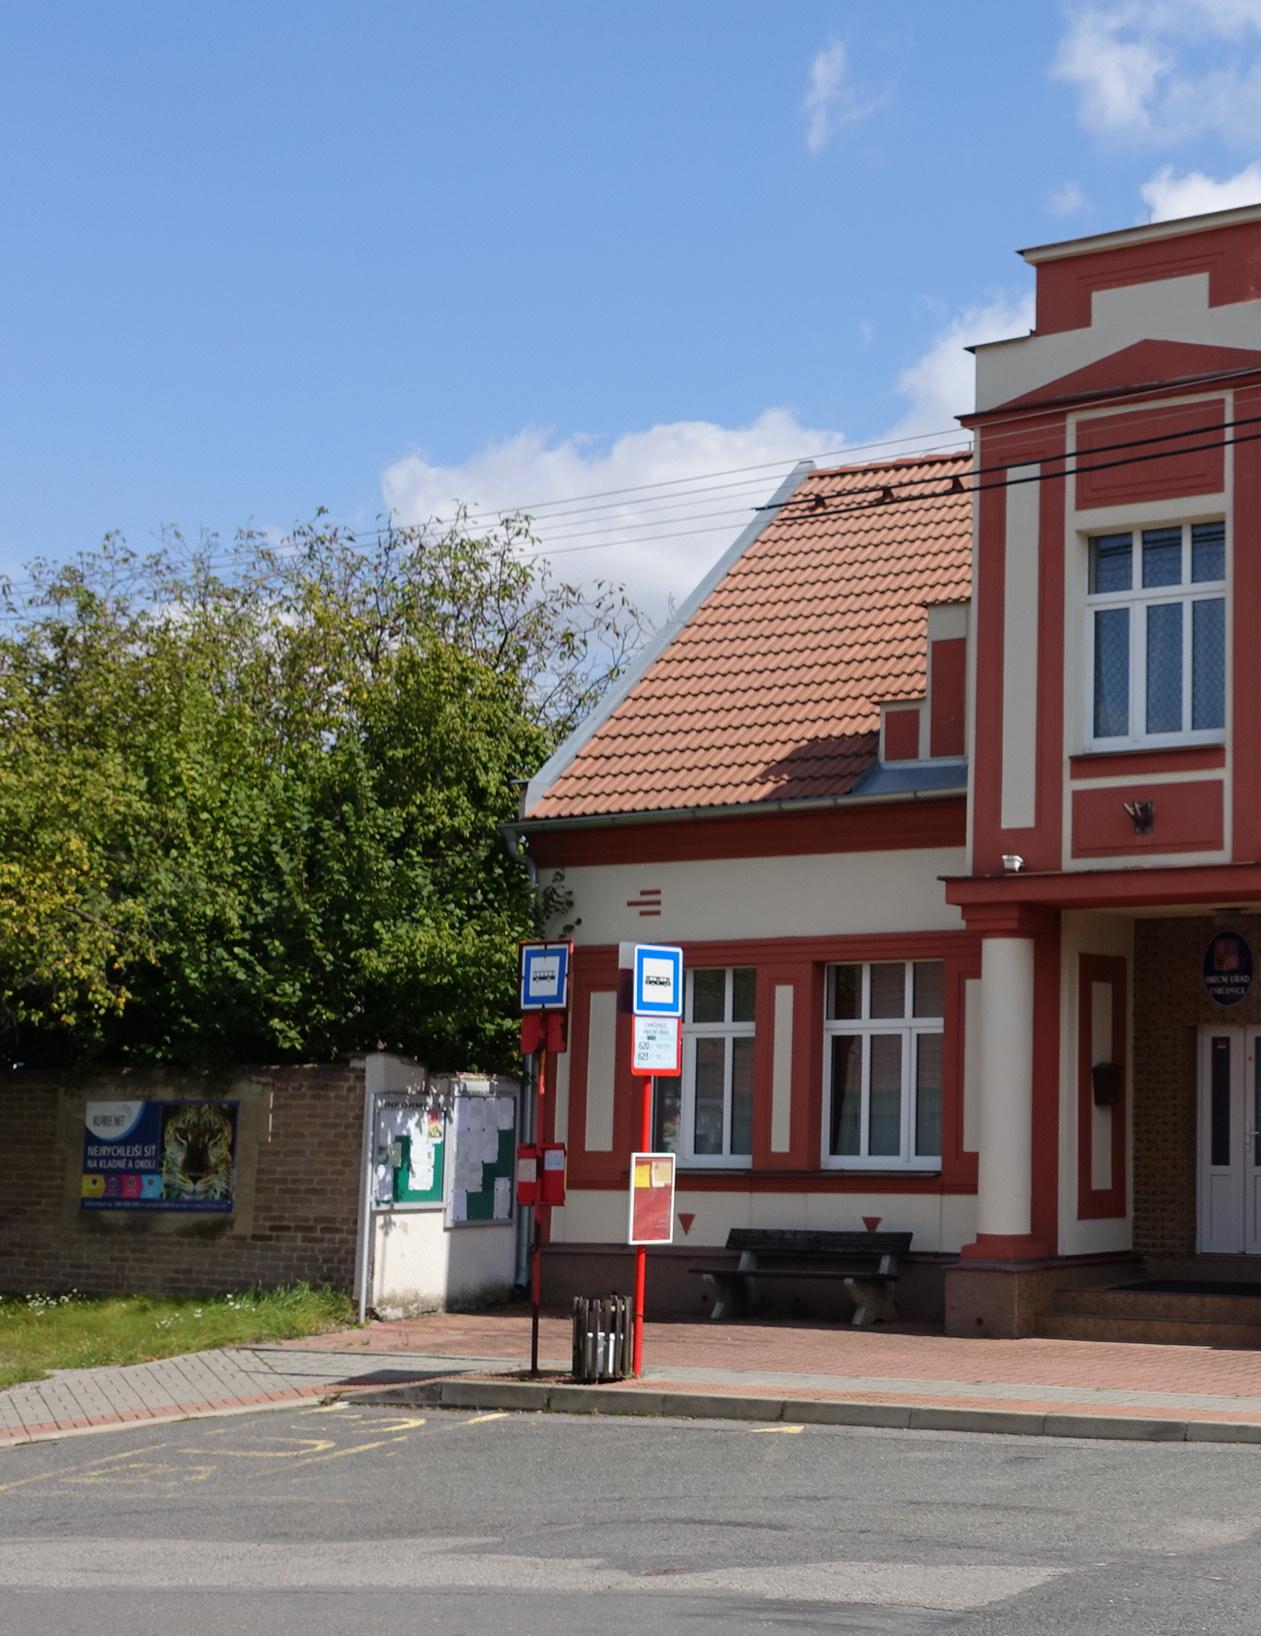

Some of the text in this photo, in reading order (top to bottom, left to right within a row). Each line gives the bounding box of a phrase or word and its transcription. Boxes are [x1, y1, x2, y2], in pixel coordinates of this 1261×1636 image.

[638, 1041, 650, 1050] 620
[87, 1159, 97, 1169] NA
[127, 1160, 133, 1169] A
